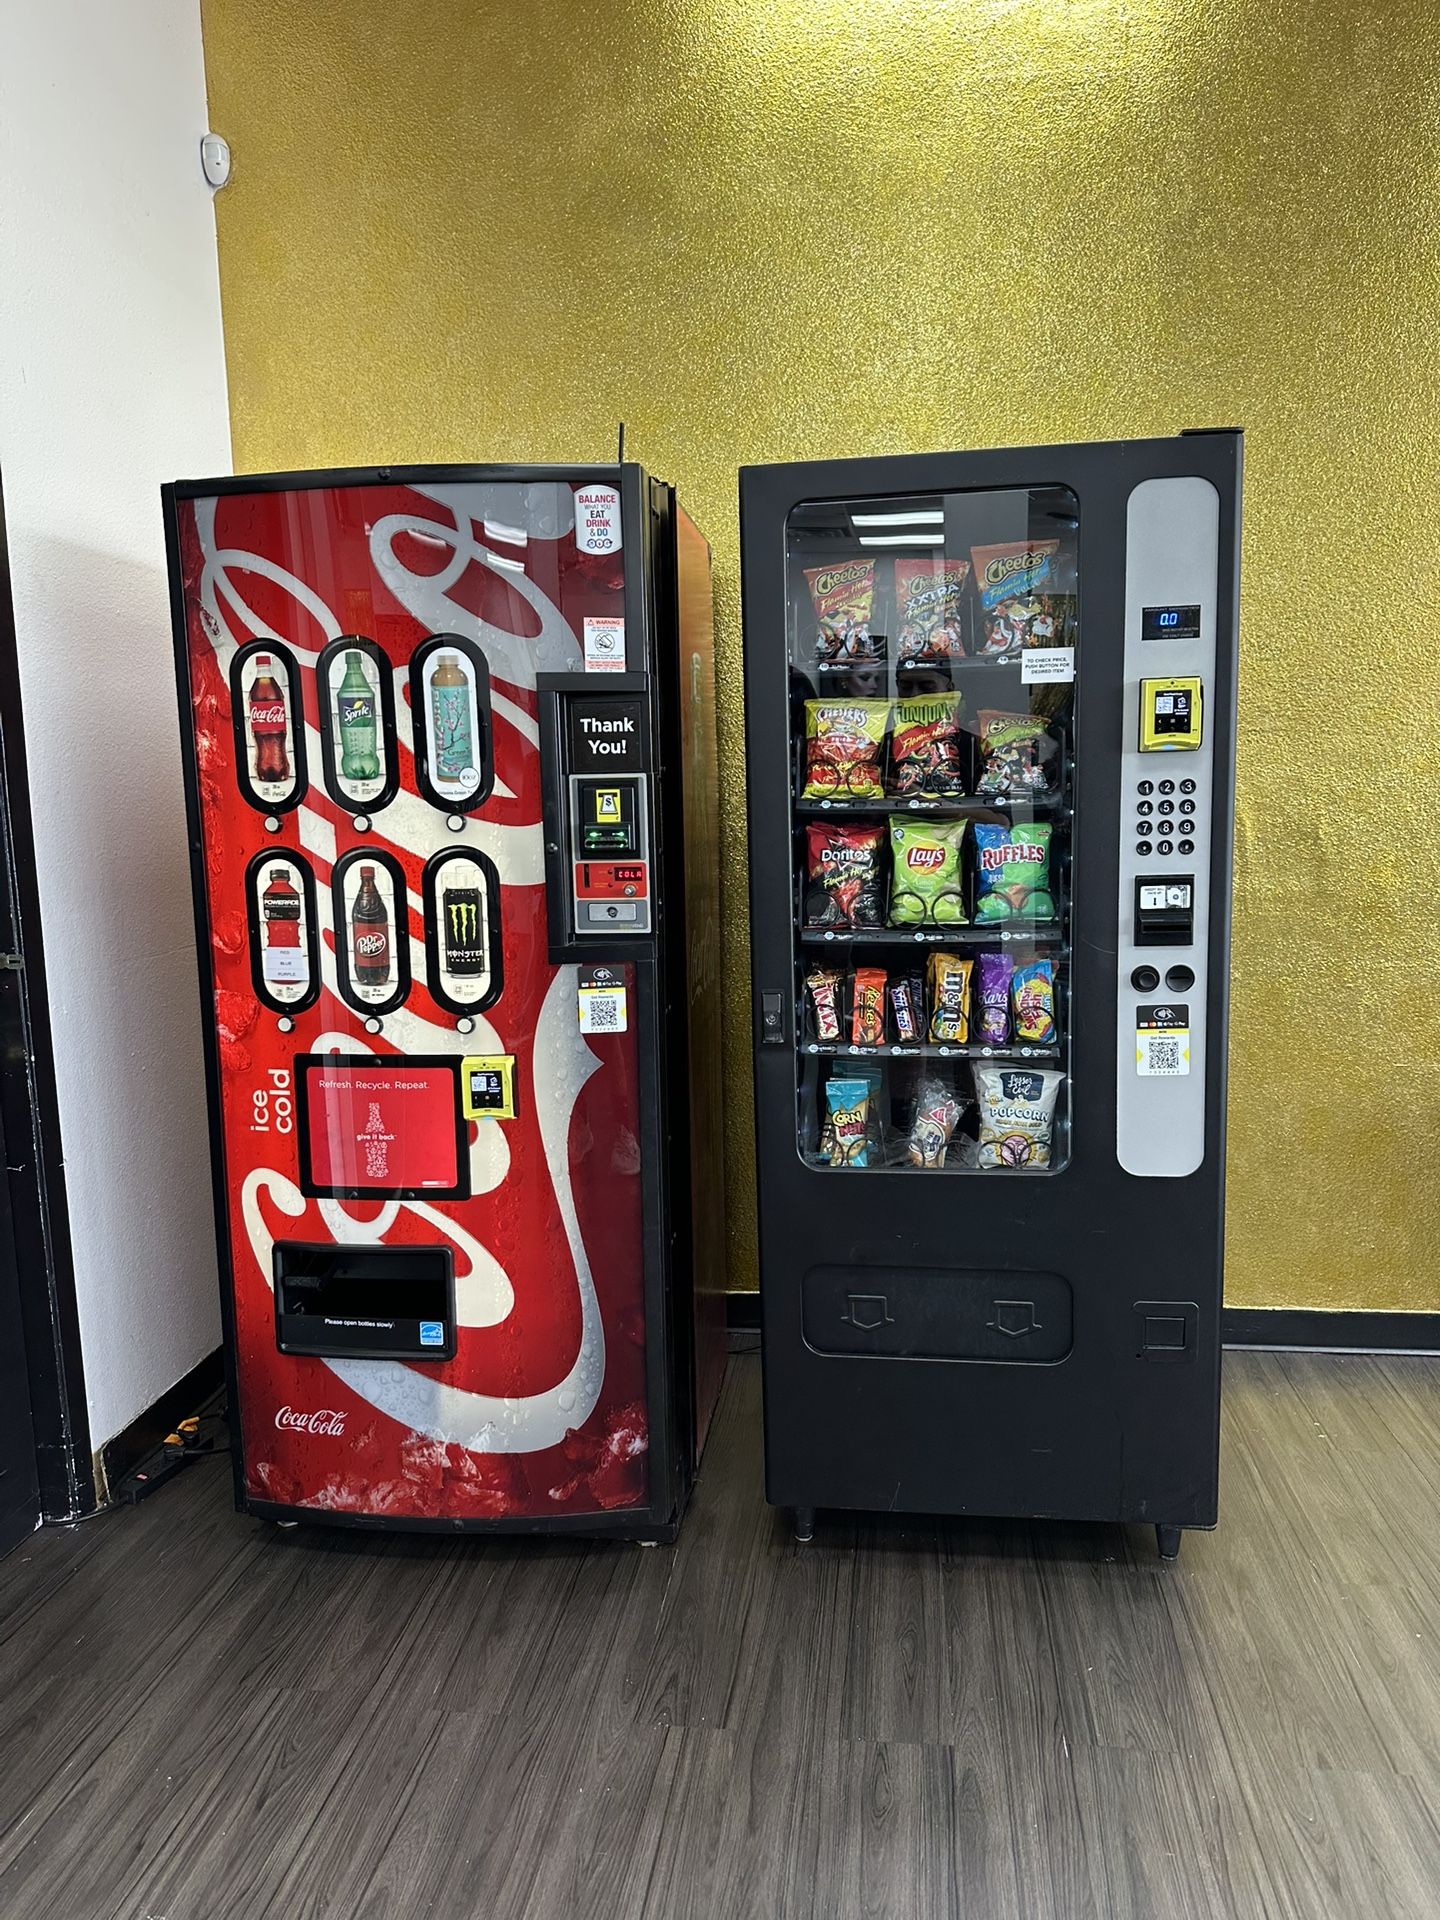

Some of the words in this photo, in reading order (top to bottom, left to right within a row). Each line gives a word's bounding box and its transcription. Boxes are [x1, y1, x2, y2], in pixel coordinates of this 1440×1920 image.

[579, 495, 616, 503] BALANCE
[590, 510, 605, 518] EAT
[590, 528, 596, 536] &
[597, 528, 608, 536] DO
[987, 552, 1045, 584] Cheetos
[816, 566, 868, 595] Cheetos
[910, 571, 956, 596] Cheetos
[906, 583, 960, 609] XXTRA
[250, 706, 285, 723] Coca-Cola
[344, 706, 370, 721] Sprite
[580, 717, 634, 733] Thank
[588, 739, 627, 754] You!
[1165, 782, 1171, 792] 2
[1185, 781, 1192, 791] 3
[1142, 803, 1148, 813] 4
[1163, 802, 1170, 812] 5
[1184, 801, 1191, 812] 6
[1142, 823, 1148, 833] 7
[1163, 822, 1169, 832] 8
[1183, 822, 1191, 832] 9
[1162, 842, 1169, 852] 0
[821, 849, 871, 862] Doritos
[981, 843, 1045, 870] RUFFLES
[359, 937, 384, 953] Pepper
[366, 935, 378, 944] Dr
[447, 950, 484, 958] MONSTER
[319, 1080, 353, 1088] Refresh.
[355, 1081, 393, 1090] Recycle.
[394, 1081, 430, 1090] Repeat.
[1008, 1074, 1033, 1087] Lesser
[268, 1069, 292, 1133] cold
[250, 1089, 270, 1132] ice
[991, 1107, 1050, 1122] POPCORN
[832, 1110, 862, 1126] CORN
[376, 1321, 393, 1329] slowly
